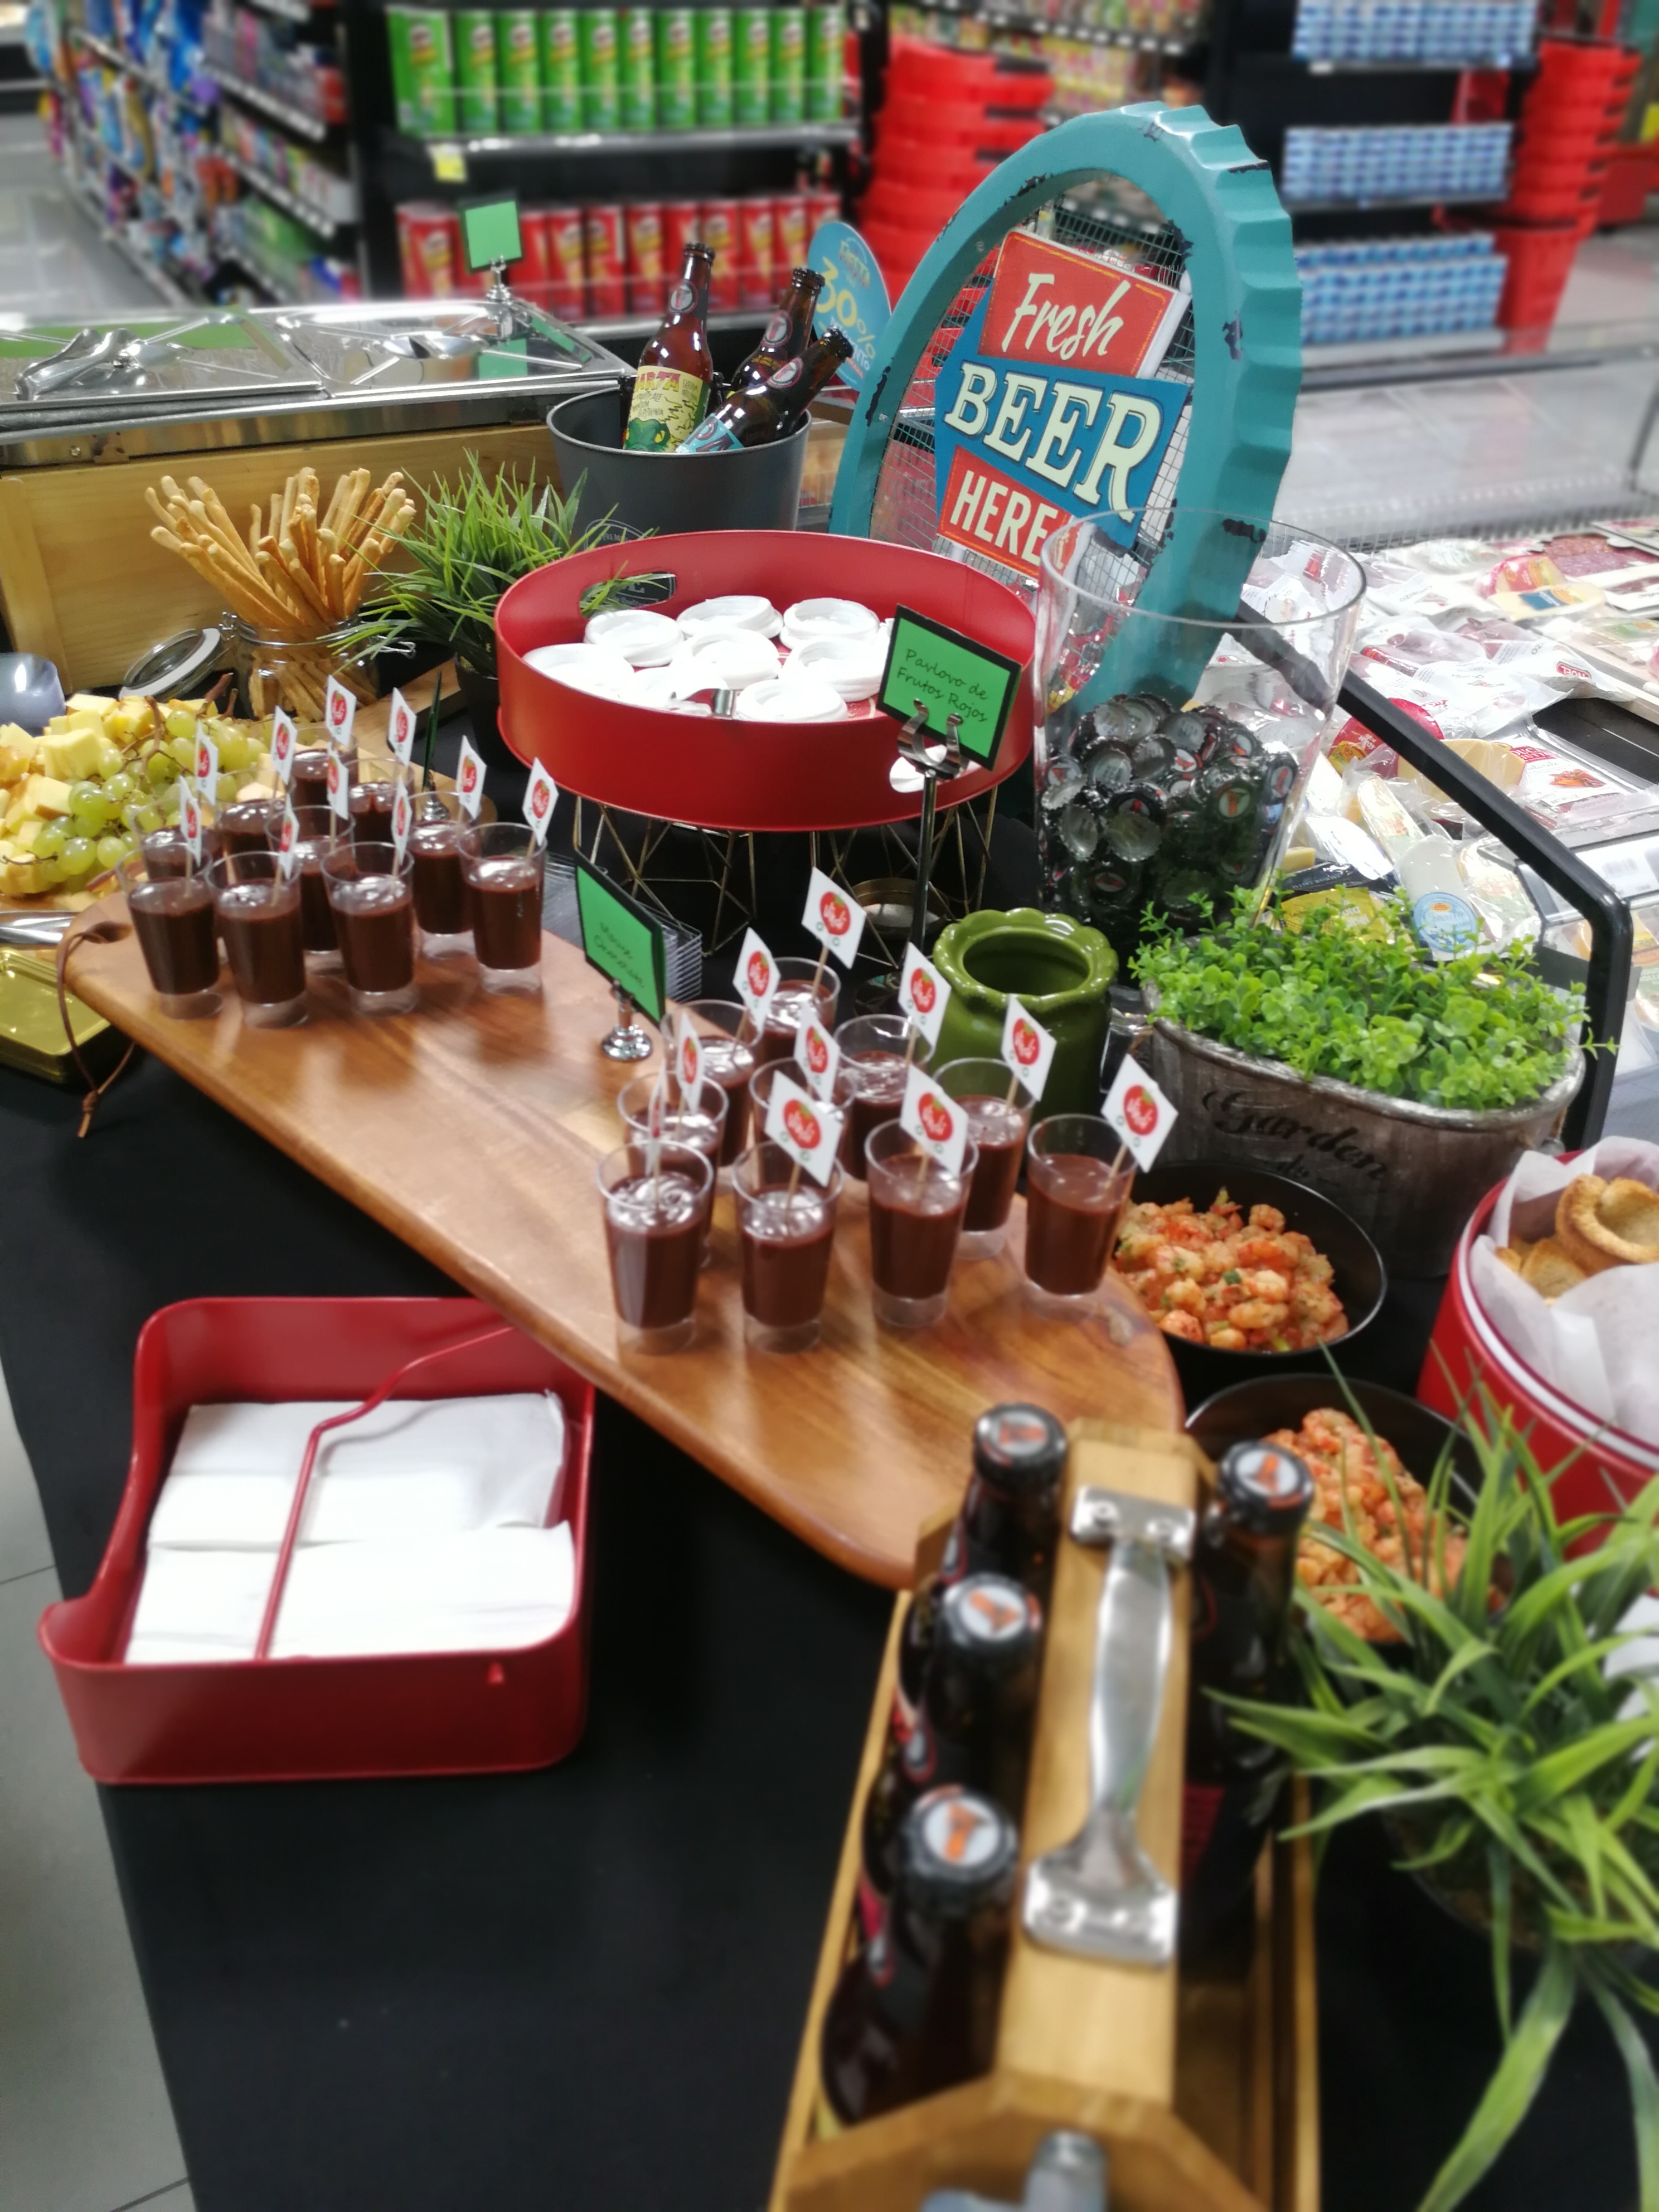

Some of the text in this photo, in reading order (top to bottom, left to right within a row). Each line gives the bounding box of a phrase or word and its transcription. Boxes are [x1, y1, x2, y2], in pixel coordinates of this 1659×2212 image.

[1002, 273, 1131, 361] Fresh
[943, 362, 1163, 523] BEER
[950, 469, 1058, 566] HERE
[896, 667, 988, 723] Frutos Rojos
[969, 683, 988, 700] de
[1202, 1091, 1388, 1179] Garden
